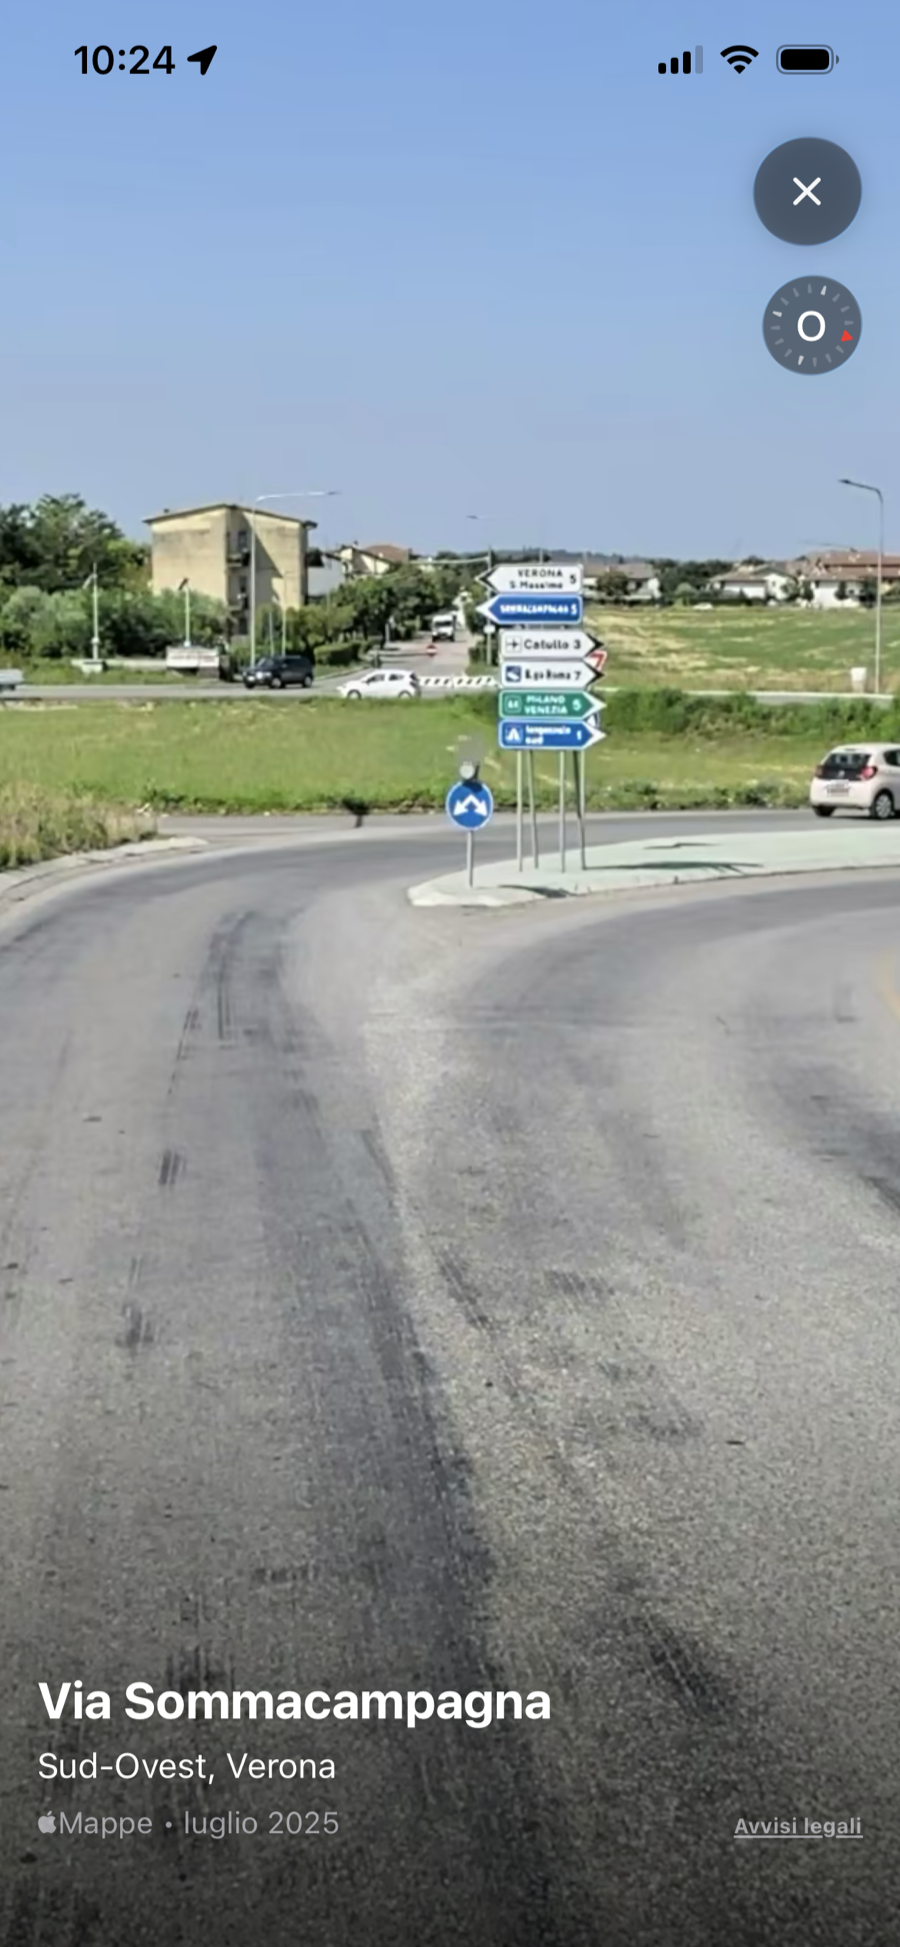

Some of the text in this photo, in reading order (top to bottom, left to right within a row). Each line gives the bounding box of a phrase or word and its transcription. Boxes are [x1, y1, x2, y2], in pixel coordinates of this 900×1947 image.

[517, 569, 564, 578] VERONA
[519, 580, 564, 589] Massimo
[569, 574, 577, 585] 5
[523, 639, 581, 650] Catullo 3
[545, 669, 571, 680] Roma
[574, 671, 581, 680] 7
[525, 695, 566, 704] MILANO
[524, 705, 568, 715] VENEZIA
[572, 699, 582, 711] 5
